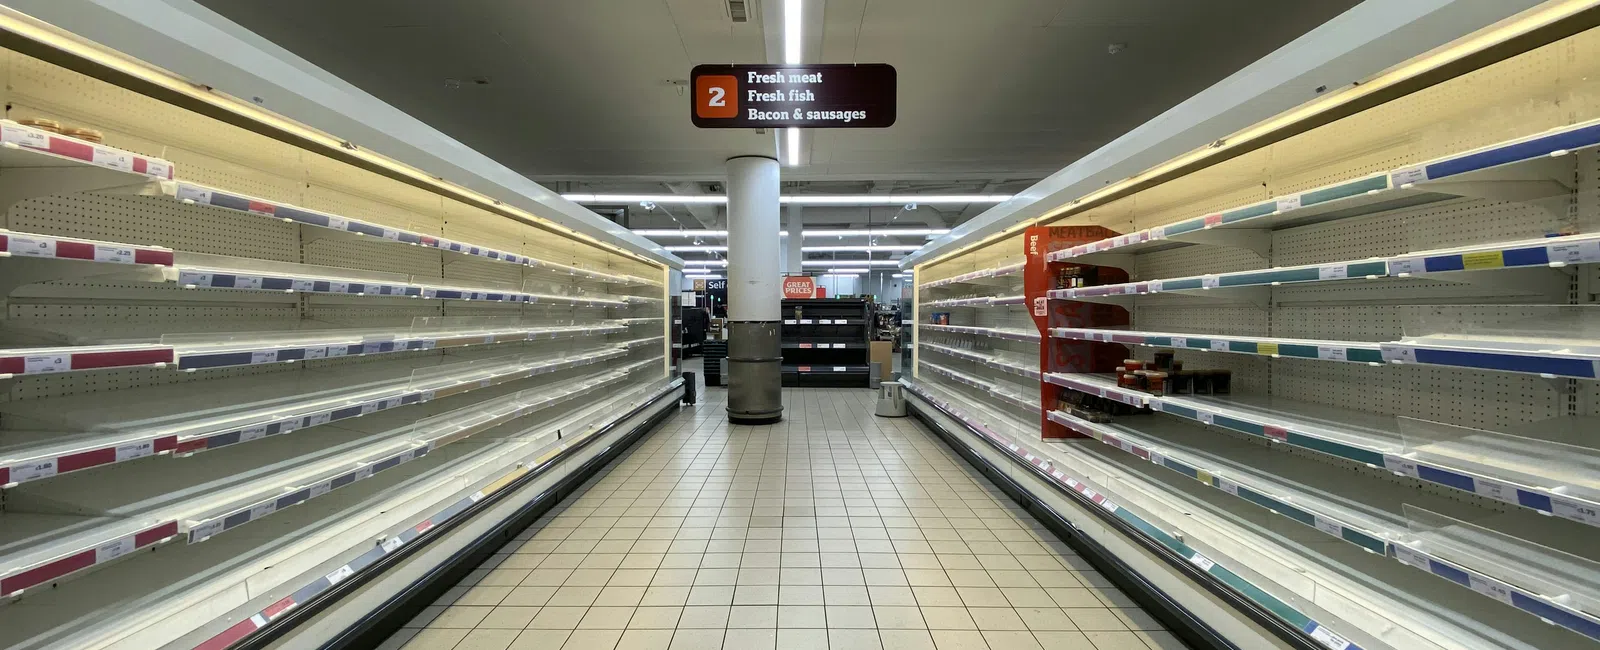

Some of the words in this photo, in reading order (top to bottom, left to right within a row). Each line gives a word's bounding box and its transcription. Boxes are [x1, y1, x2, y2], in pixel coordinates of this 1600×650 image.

[747, 71, 785, 84] Fresh
[788, 71, 823, 84] meat
[709, 87, 726, 107] 2
[747, 89, 785, 102] Fresh
[788, 89, 815, 102] fish
[747, 108, 790, 120] Bacon
[792, 108, 804, 120] &
[806, 109, 866, 122] sausages
[1029, 234, 1039, 256] Beef
[708, 281, 725, 289] Self
